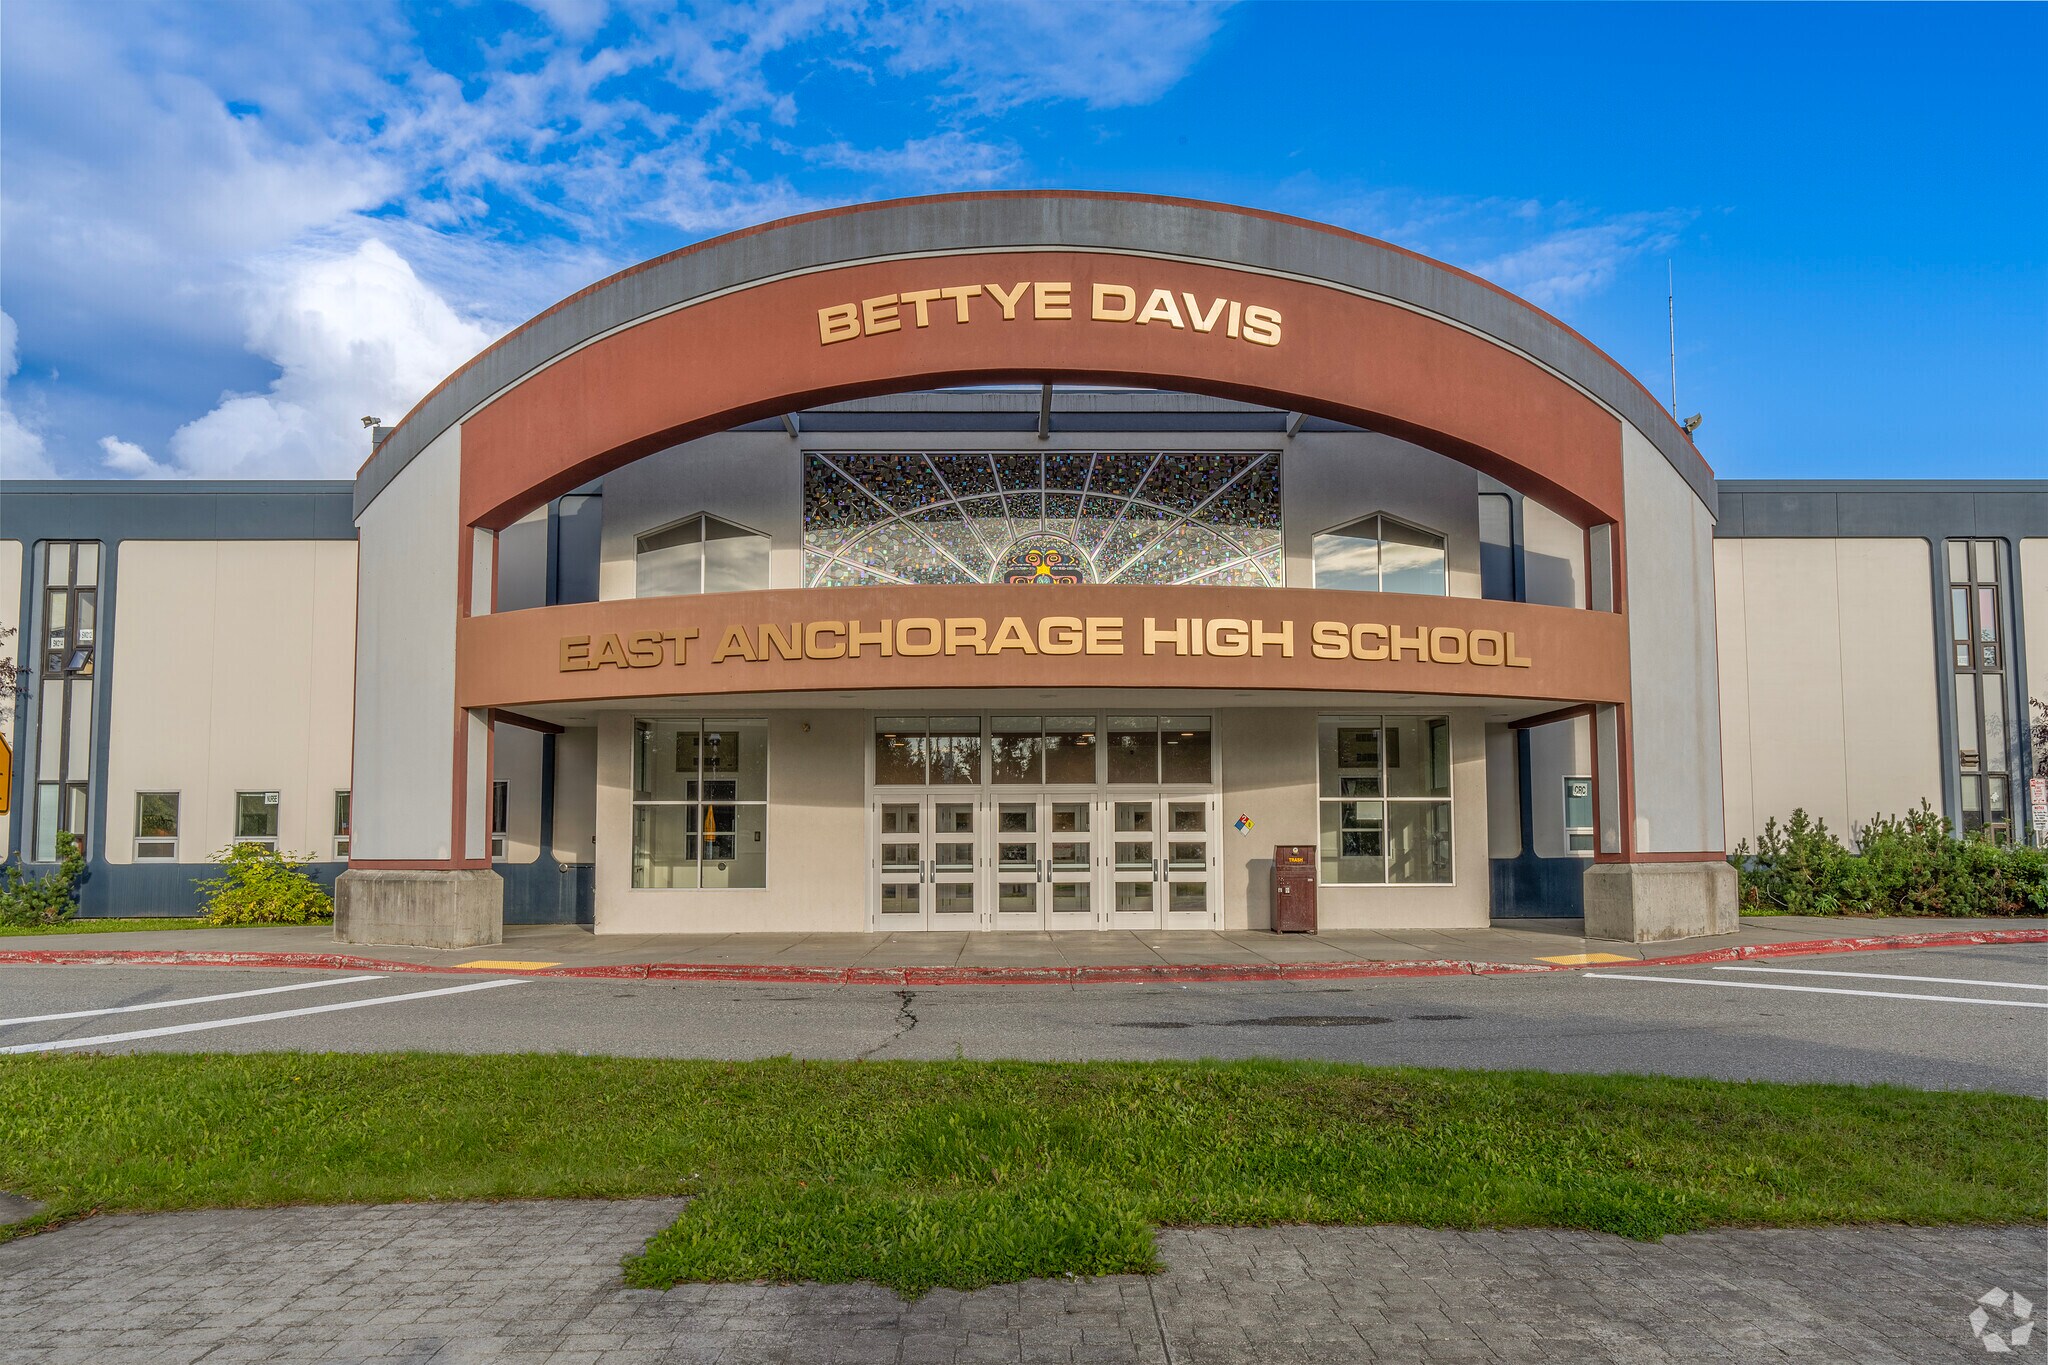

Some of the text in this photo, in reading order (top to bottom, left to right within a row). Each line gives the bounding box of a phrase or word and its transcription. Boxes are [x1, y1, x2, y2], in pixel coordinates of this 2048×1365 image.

[818, 281, 1282, 347] BETTYE DAVIS
[559, 616, 1532, 672] EAST ANCHORAGE HIGH SCHOOL
[1241, 815, 1247, 823] 2
